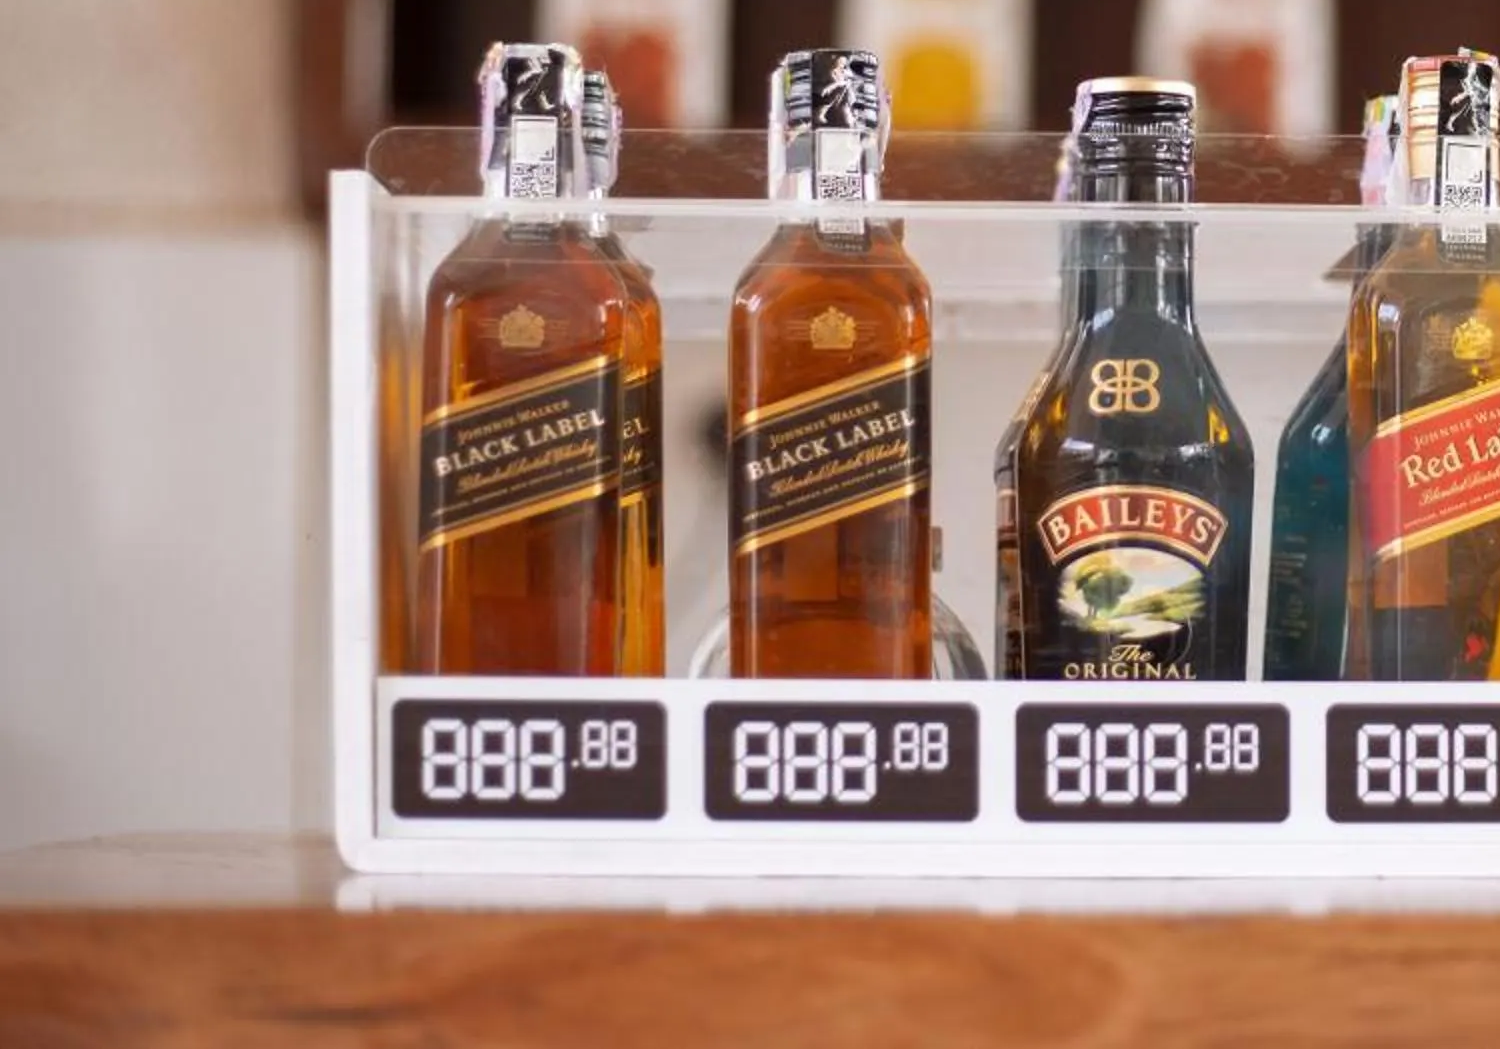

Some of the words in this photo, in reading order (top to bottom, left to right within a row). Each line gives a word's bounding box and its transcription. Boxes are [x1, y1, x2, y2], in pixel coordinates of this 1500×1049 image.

[435, 434, 520, 477] BLACK
[523, 409, 605, 447] LABEL
[457, 420, 516, 445] JOHNNIE
[517, 400, 571, 424] WALKER
[747, 437, 830, 481] BLACK
[834, 408, 916, 449] LABEL
[770, 420, 827, 450] JOHNNIE
[828, 400, 881, 424] WALKER
[1413, 420, 1472, 451] JOHNNIE
[1401, 442, 1464, 488] Red
[1048, 496, 1217, 547] BAILEYS
[1064, 662, 1197, 680] ORIGINAL
[1107, 643, 1151, 663] The
